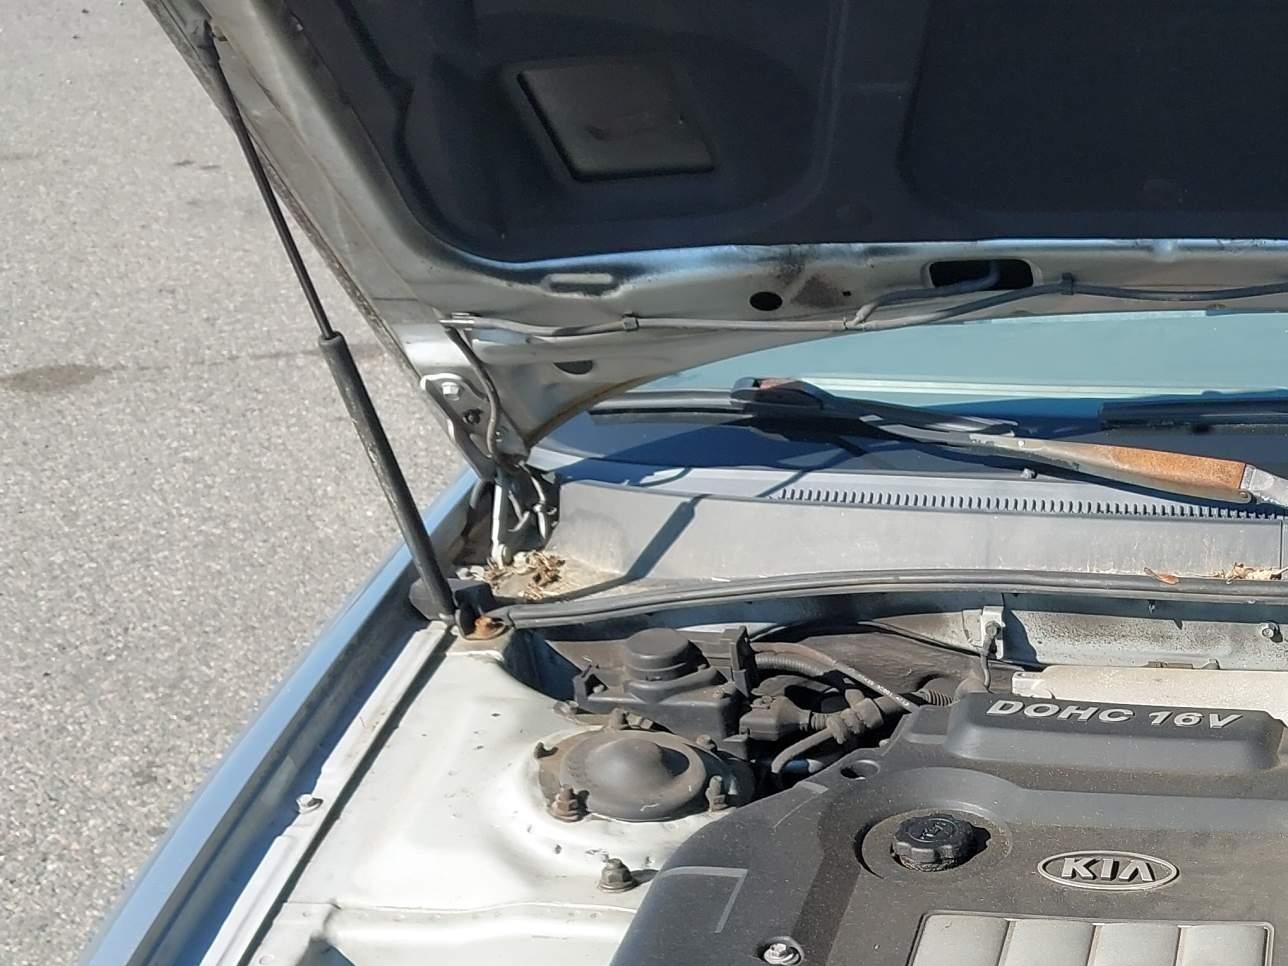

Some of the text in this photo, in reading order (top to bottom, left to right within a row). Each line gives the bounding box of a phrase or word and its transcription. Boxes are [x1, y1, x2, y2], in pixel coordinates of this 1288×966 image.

[985, 698, 1244, 730] DOHC 16V
[1059, 856, 1156, 884] KIA
